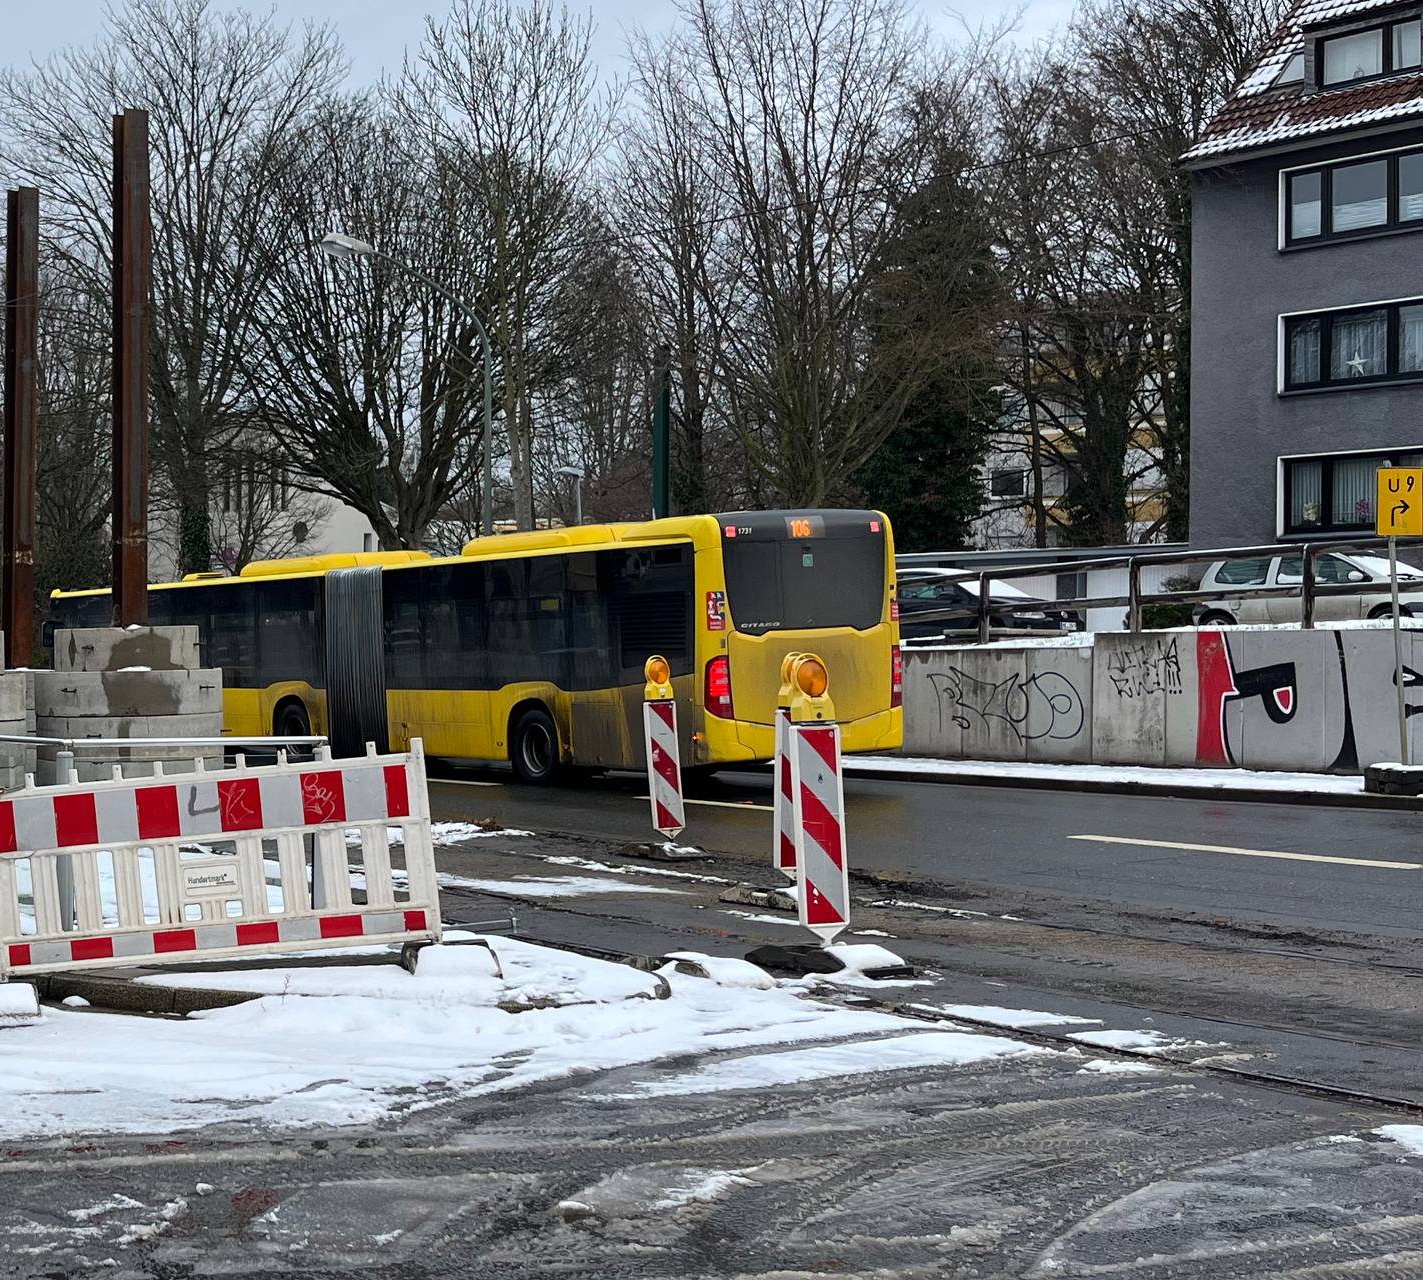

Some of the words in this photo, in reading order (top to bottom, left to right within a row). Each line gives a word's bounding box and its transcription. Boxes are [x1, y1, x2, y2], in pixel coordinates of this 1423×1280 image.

[1388, 478, 1400, 492] U
[1406, 475, 1415, 493] 9
[738, 527, 752, 535] 1731
[790, 519, 811, 538] 106
